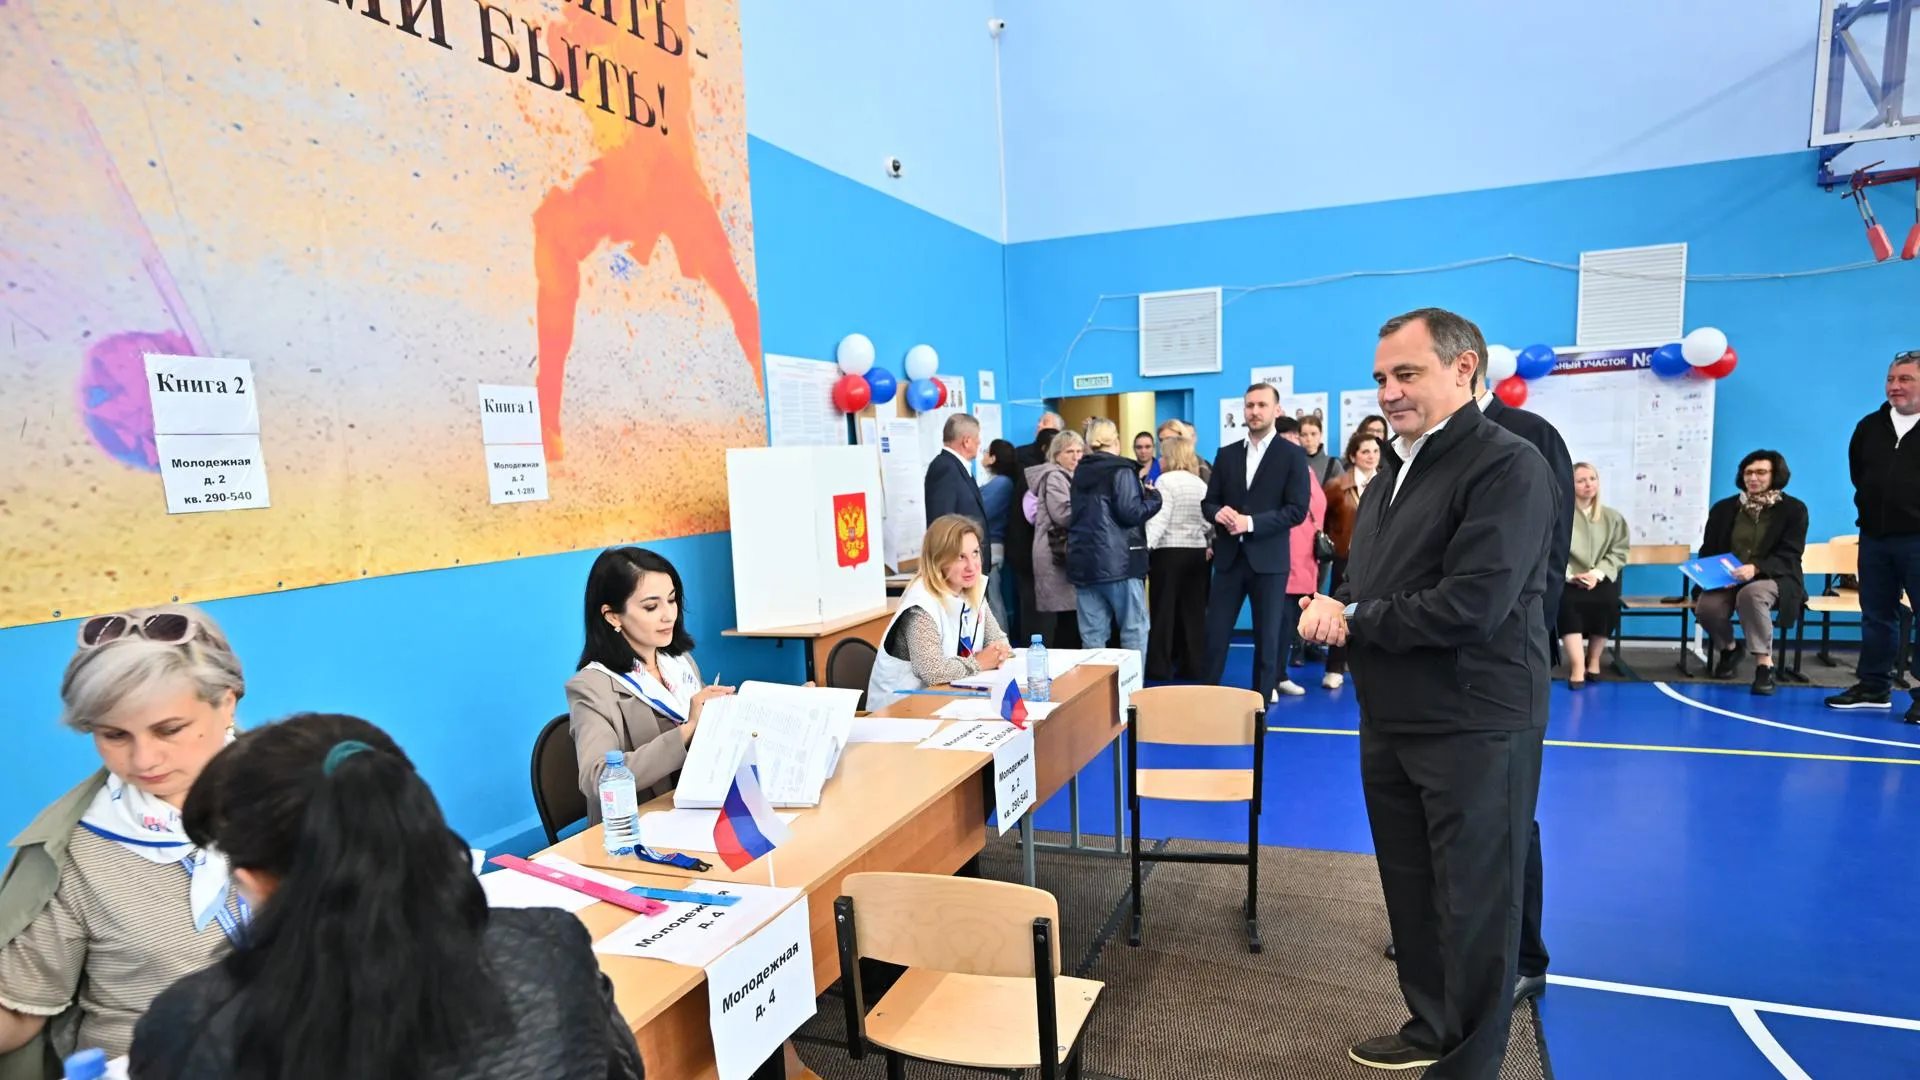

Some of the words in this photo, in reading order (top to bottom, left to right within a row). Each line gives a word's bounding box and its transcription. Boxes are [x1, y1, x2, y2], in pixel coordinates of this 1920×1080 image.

[476, 0, 669, 136] БЫТЬ!
[1582, 356, 1627, 368] УЧАСТОК
[156, 372, 228, 394] Книга
[233, 376, 246, 394] 2
[483, 398, 525, 414] Книга
[528, 400, 534, 414] 1
[171, 458, 251, 469] Молодежная
[493, 462, 540, 470] Молодежная
[203, 476, 215, 486] д.
[218, 475, 226, 484] 2
[520, 474, 525, 482] 2
[184, 495, 202, 505] кв.
[204, 490, 252, 503] 290-540
[517, 486, 536, 496] 1-289
[998, 753, 1030, 783] Молодежная
[1016, 778, 1020, 787] 2
[634, 889, 731, 949] Молодежя
[697, 917, 715, 931] д.
[713, 911, 726, 920] 4
[721, 942, 799, 1014] Молодежная
[755, 1004, 767, 1022] д.
[768, 989, 777, 1004] 4
